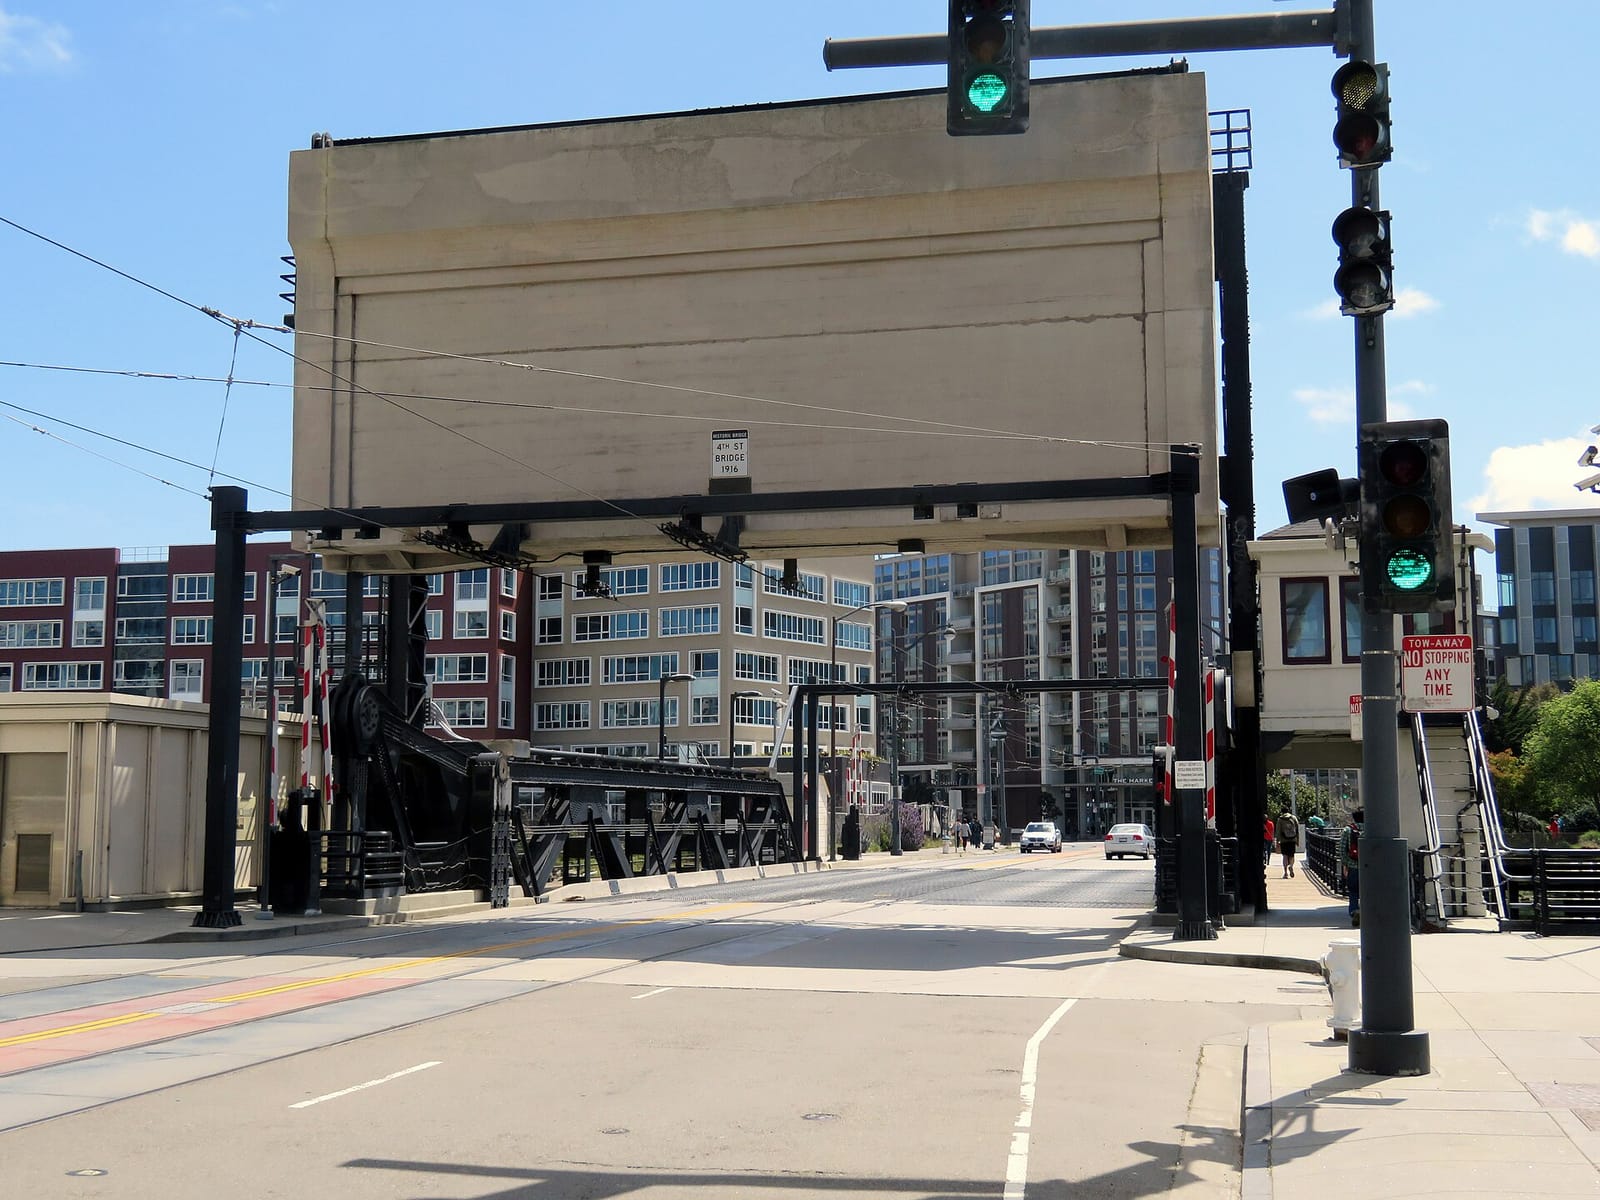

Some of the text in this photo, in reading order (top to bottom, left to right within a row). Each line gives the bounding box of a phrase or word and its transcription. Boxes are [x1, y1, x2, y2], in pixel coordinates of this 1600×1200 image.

[717, 442, 743, 451] 4TH ST
[715, 454, 745, 462] BRIDGE
[721, 465, 738, 473] 1916
[1409, 638, 1464, 648] TOW-AWAY
[1403, 650, 1469, 666] NO STOPPING
[1425, 668, 1451, 681] ANY
[1423, 683, 1453, 696] TIME
